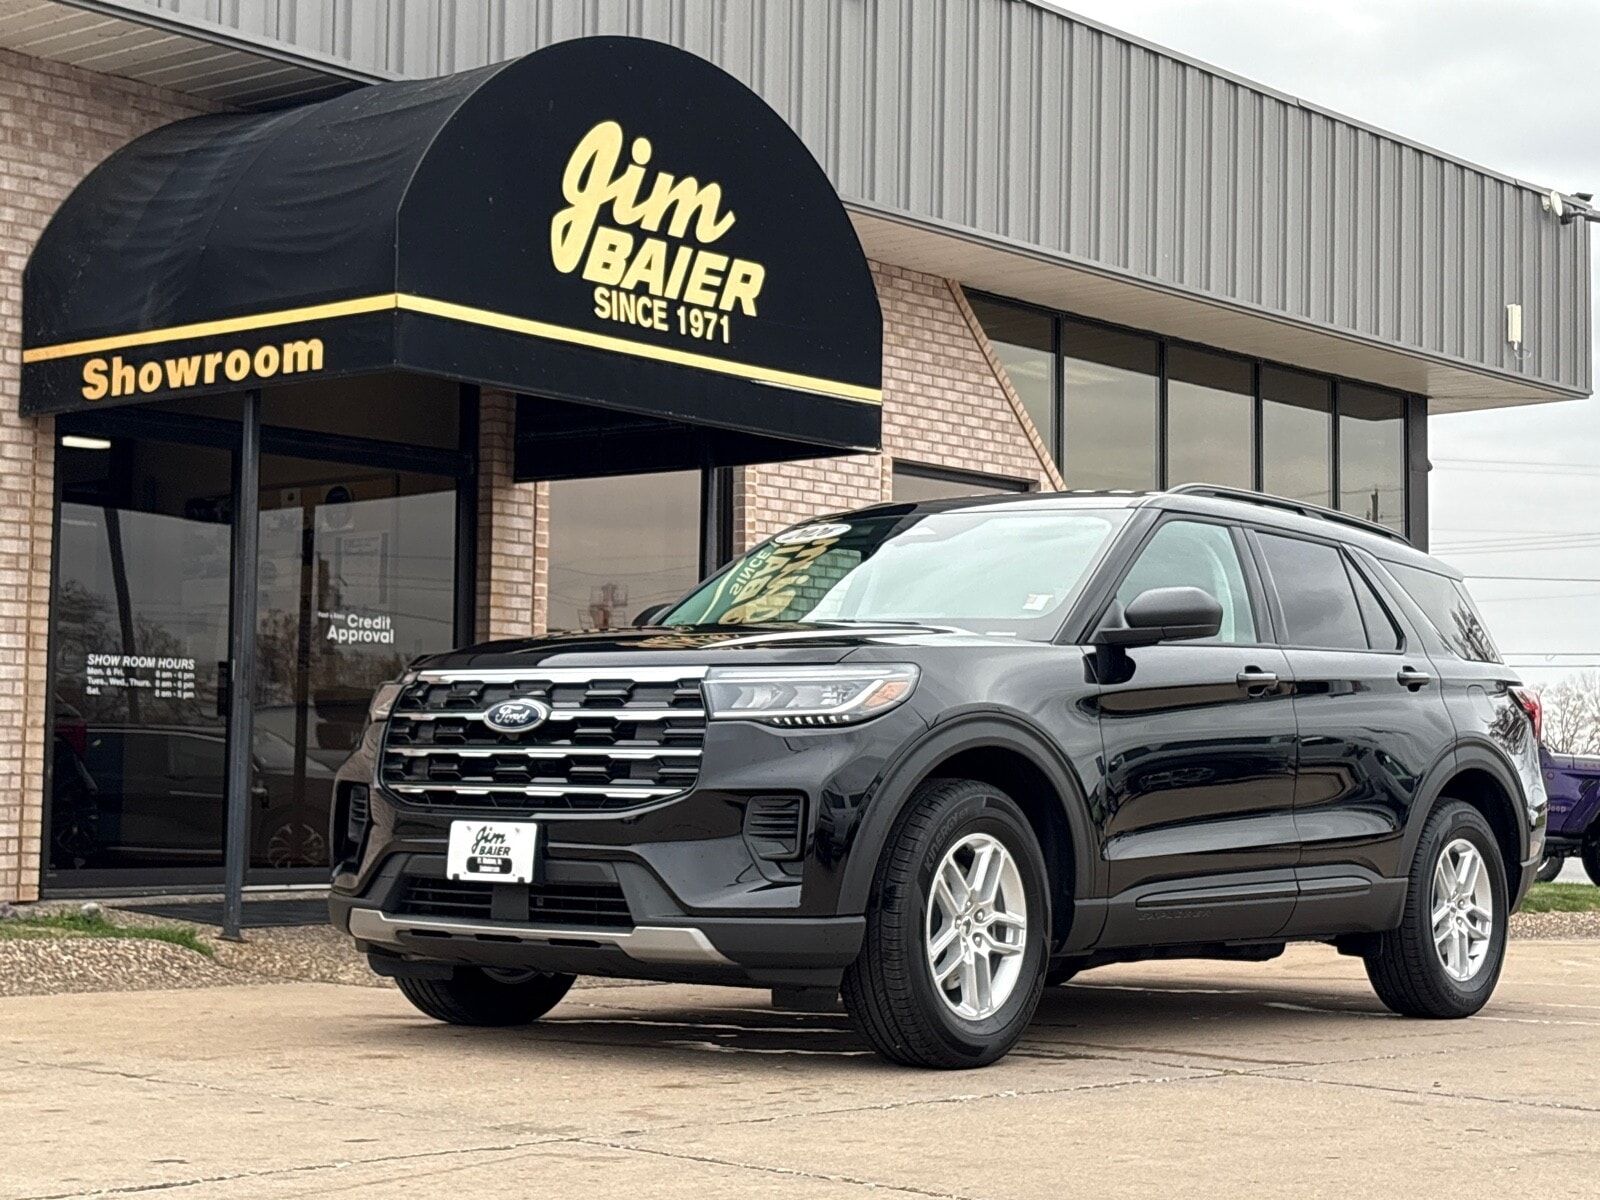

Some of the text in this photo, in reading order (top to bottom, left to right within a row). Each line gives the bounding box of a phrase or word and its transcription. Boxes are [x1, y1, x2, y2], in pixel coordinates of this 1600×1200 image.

[550, 120, 736, 274] Jim
[582, 226, 767, 317] BAIER
[594, 287, 731, 344] SINCE 1971
[81, 338, 325, 400] Showroom
[347, 613, 391, 629] Credit
[326, 624, 394, 644] Approval
[87, 653, 195, 670] SHOW ROOM HOURS
[494, 705, 530, 723] Ford
[471, 825, 506, 854] Jim
[479, 846, 511, 856] BAIER
